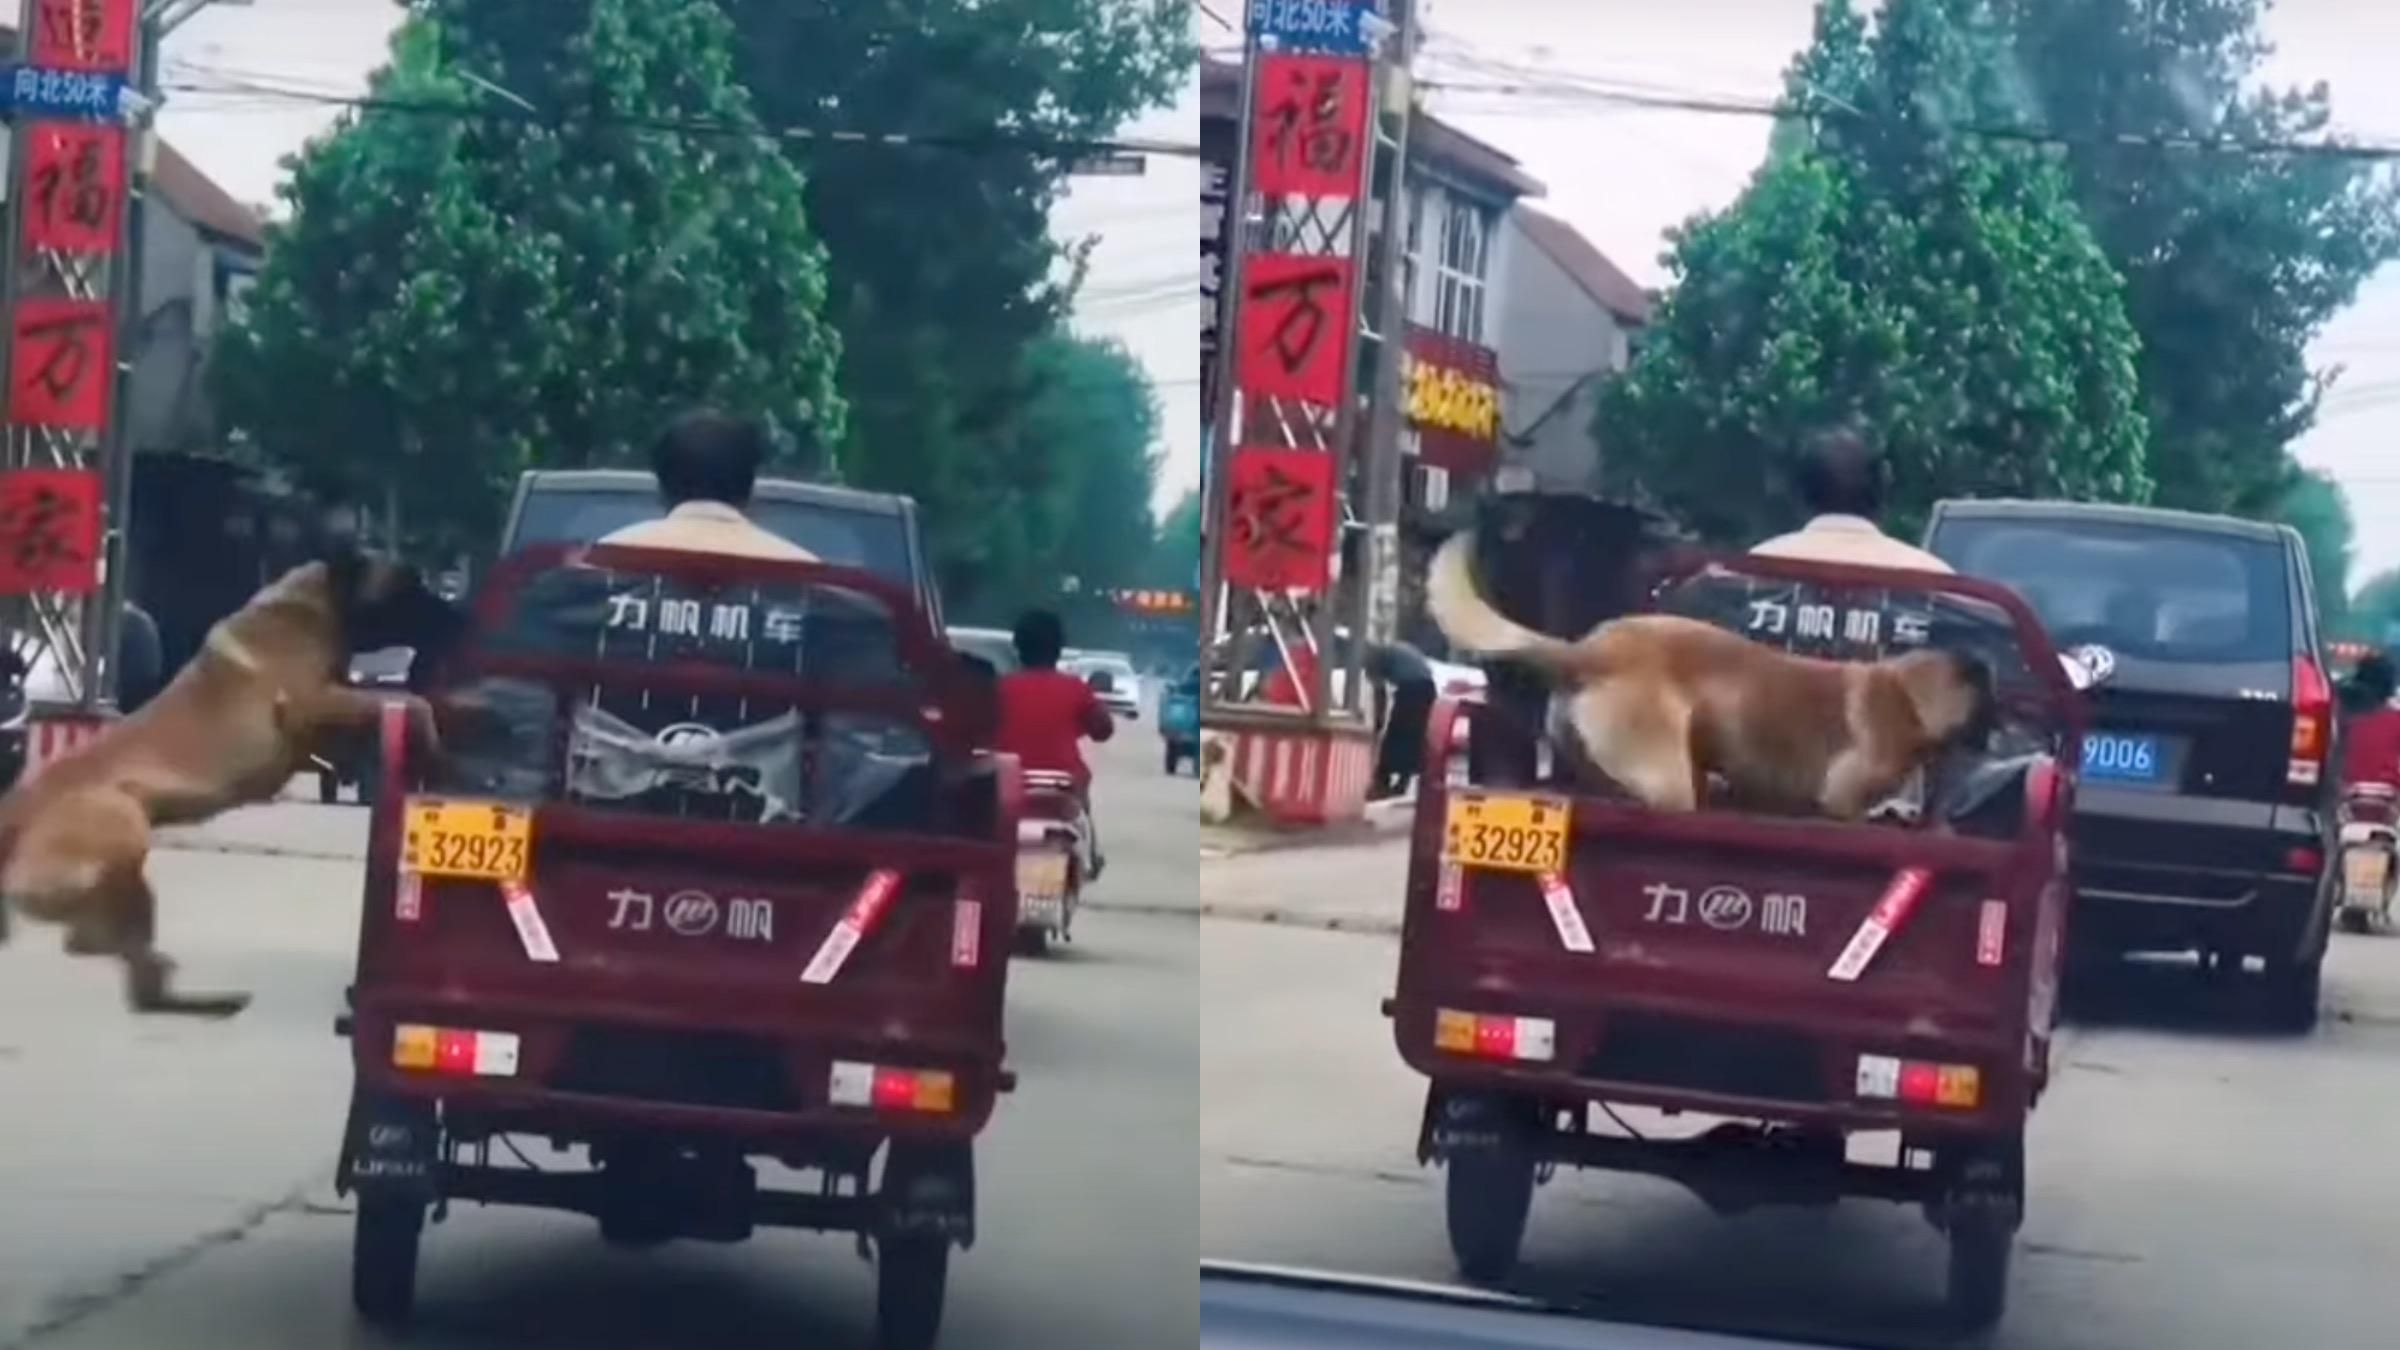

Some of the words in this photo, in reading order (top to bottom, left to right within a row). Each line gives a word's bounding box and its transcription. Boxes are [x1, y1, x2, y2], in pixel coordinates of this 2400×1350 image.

[14, 67, 110, 109] 向北50米
[1258, 68, 1352, 174] 福
[33, 136, 106, 229] 福
[1250, 266, 1340, 375] 万
[19, 312, 102, 400] 万
[608, 594, 804, 644] 力帆机车
[1748, 599, 1931, 645] 力帆机车
[2082, 735, 2151, 769] 9006
[429, 831, 524, 875] 32923
[1470, 823, 1561, 868] 32923
